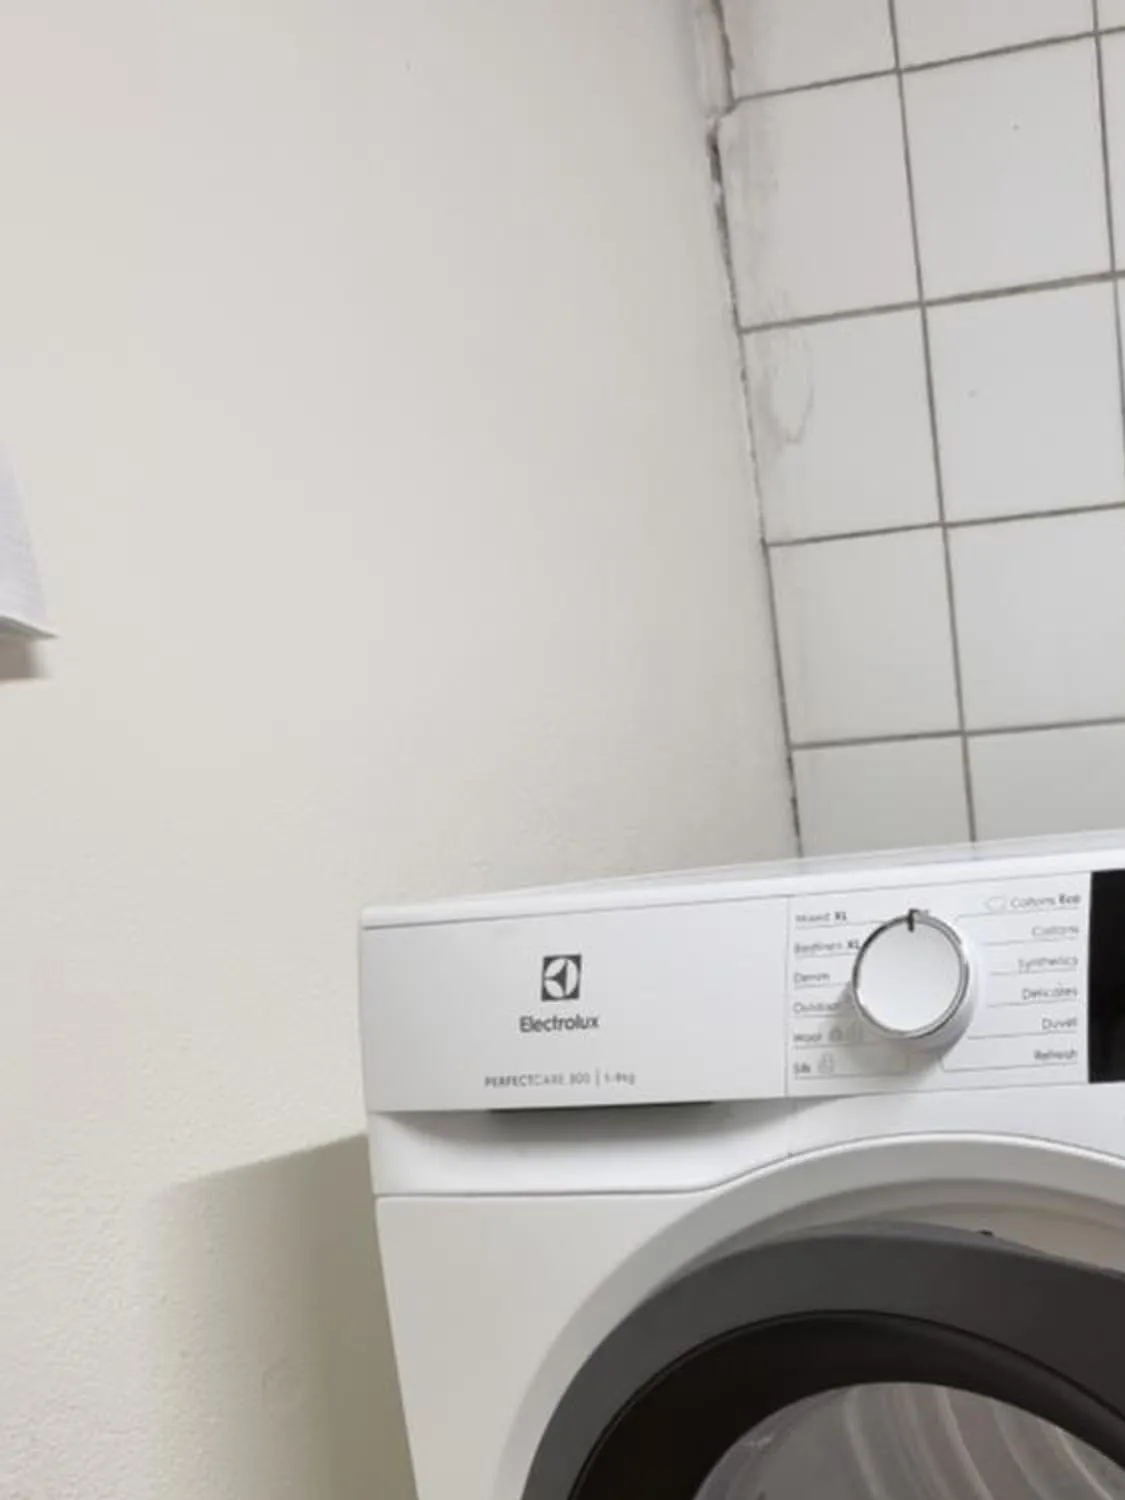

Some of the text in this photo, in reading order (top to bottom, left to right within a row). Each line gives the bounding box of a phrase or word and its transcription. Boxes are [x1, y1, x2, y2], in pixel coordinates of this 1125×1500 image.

[1017, 955, 1079, 973] Synthetics
[1020, 985, 1078, 1001] Delicates
[518, 1013, 600, 1033] Electrolux
[1041, 1017, 1078, 1031] Duvet
[484, 1072, 566, 1088] PERFECTCARE
